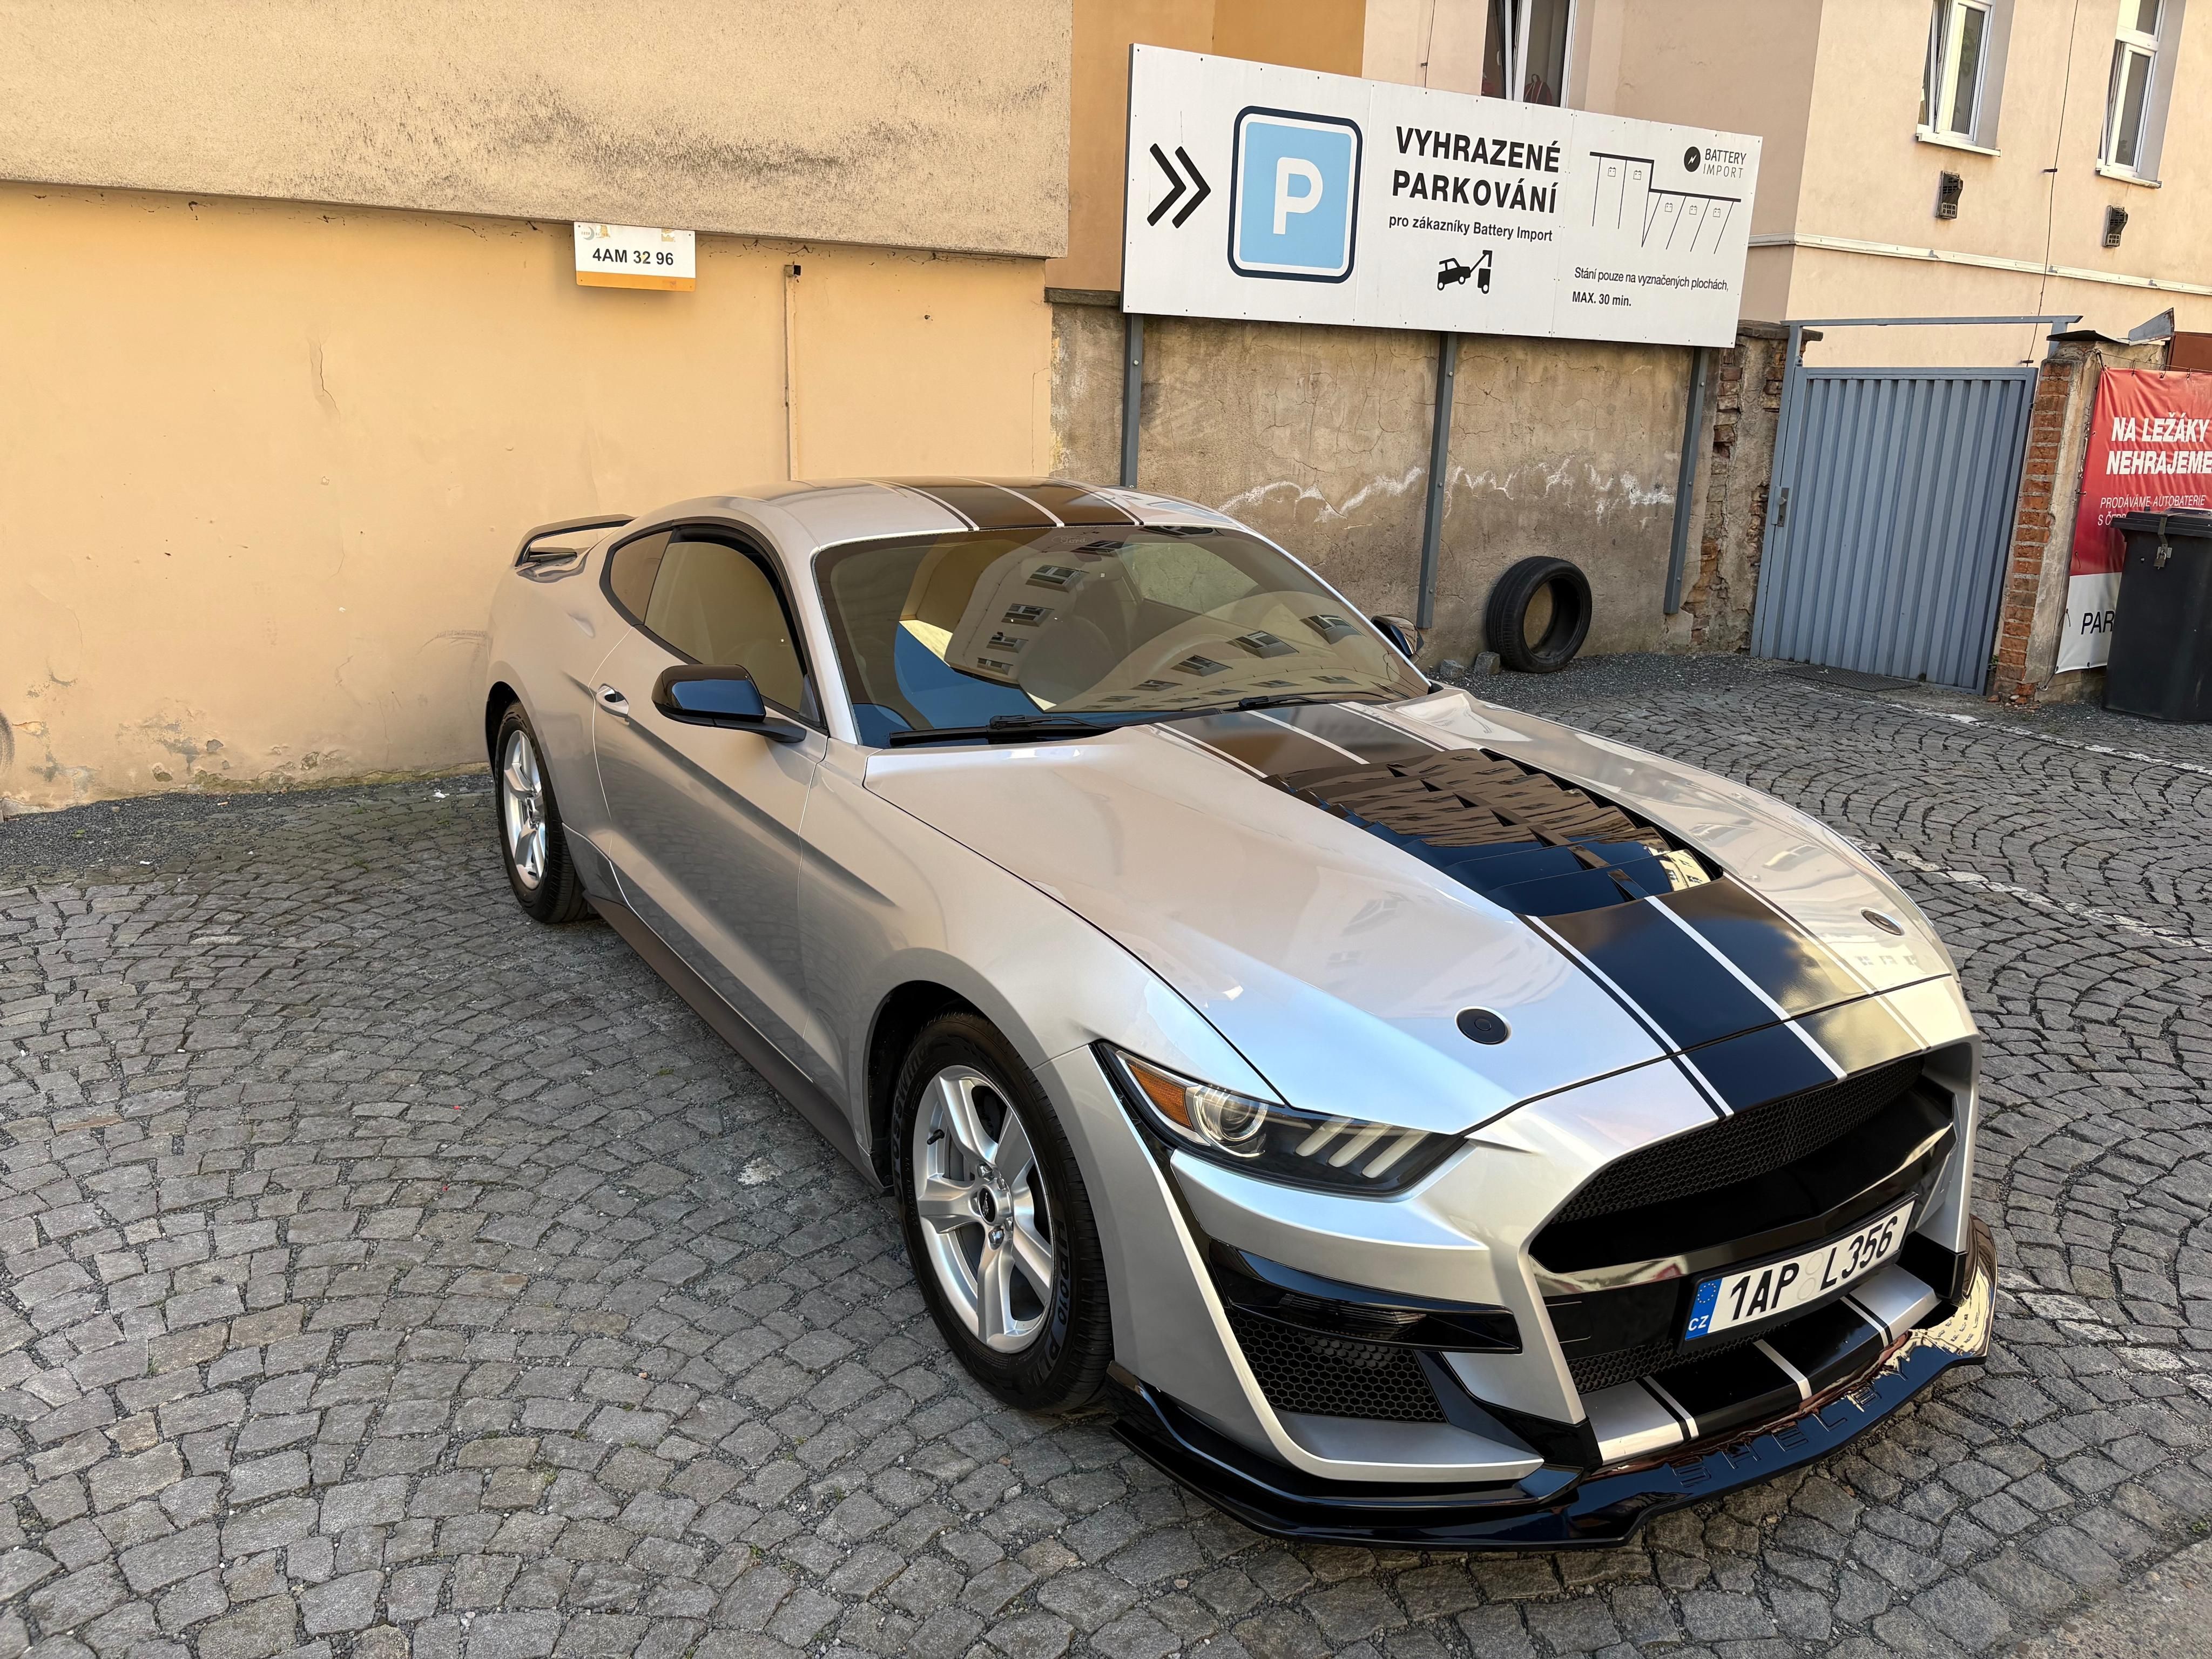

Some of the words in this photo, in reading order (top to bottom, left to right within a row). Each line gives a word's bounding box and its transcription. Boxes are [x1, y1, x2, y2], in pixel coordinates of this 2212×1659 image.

[1396, 126, 1560, 173] VYHRAZENÉ
[1705, 149, 1746, 165] BATTERY
[1703, 163, 1743, 178] IMPORT
[1272, 157, 1323, 235] P
[1393, 170, 1559, 214] PARKOVÁNÍ
[1389, 216, 1409, 228] pro
[1412, 216, 1470, 235] zákazníky
[1473, 222, 1514, 240] Battery
[1517, 226, 1553, 242] Import
[592, 248, 627, 263] 4AM
[633, 251, 651, 264] 32
[656, 252, 673, 265] 96
[1575, 267, 1597, 279] Stání
[1597, 272, 1623, 282] pouze
[1626, 273, 1636, 283] na
[1638, 274, 1689, 289] vyznačených
[1572, 291, 1596, 304] MAX.
[1599, 293, 1610, 305] 30
[1612, 295, 1631, 306] min.
[2111, 417, 2135, 442] NA
[2141, 412, 2210, 442] LEŽÁKY
[2106, 450, 2212, 475] NEHRAJEME
[2100, 494, 2152, 509] PRODÁVÁME
[2153, 494, 2206, 507] AUTOBATERIE
[2098, 515, 2103, 525] S
[1730, 1262, 1799, 1321] 1AP
[1820, 1216, 1898, 1291] L356
[1688, 1314, 1709, 1332] CZ
